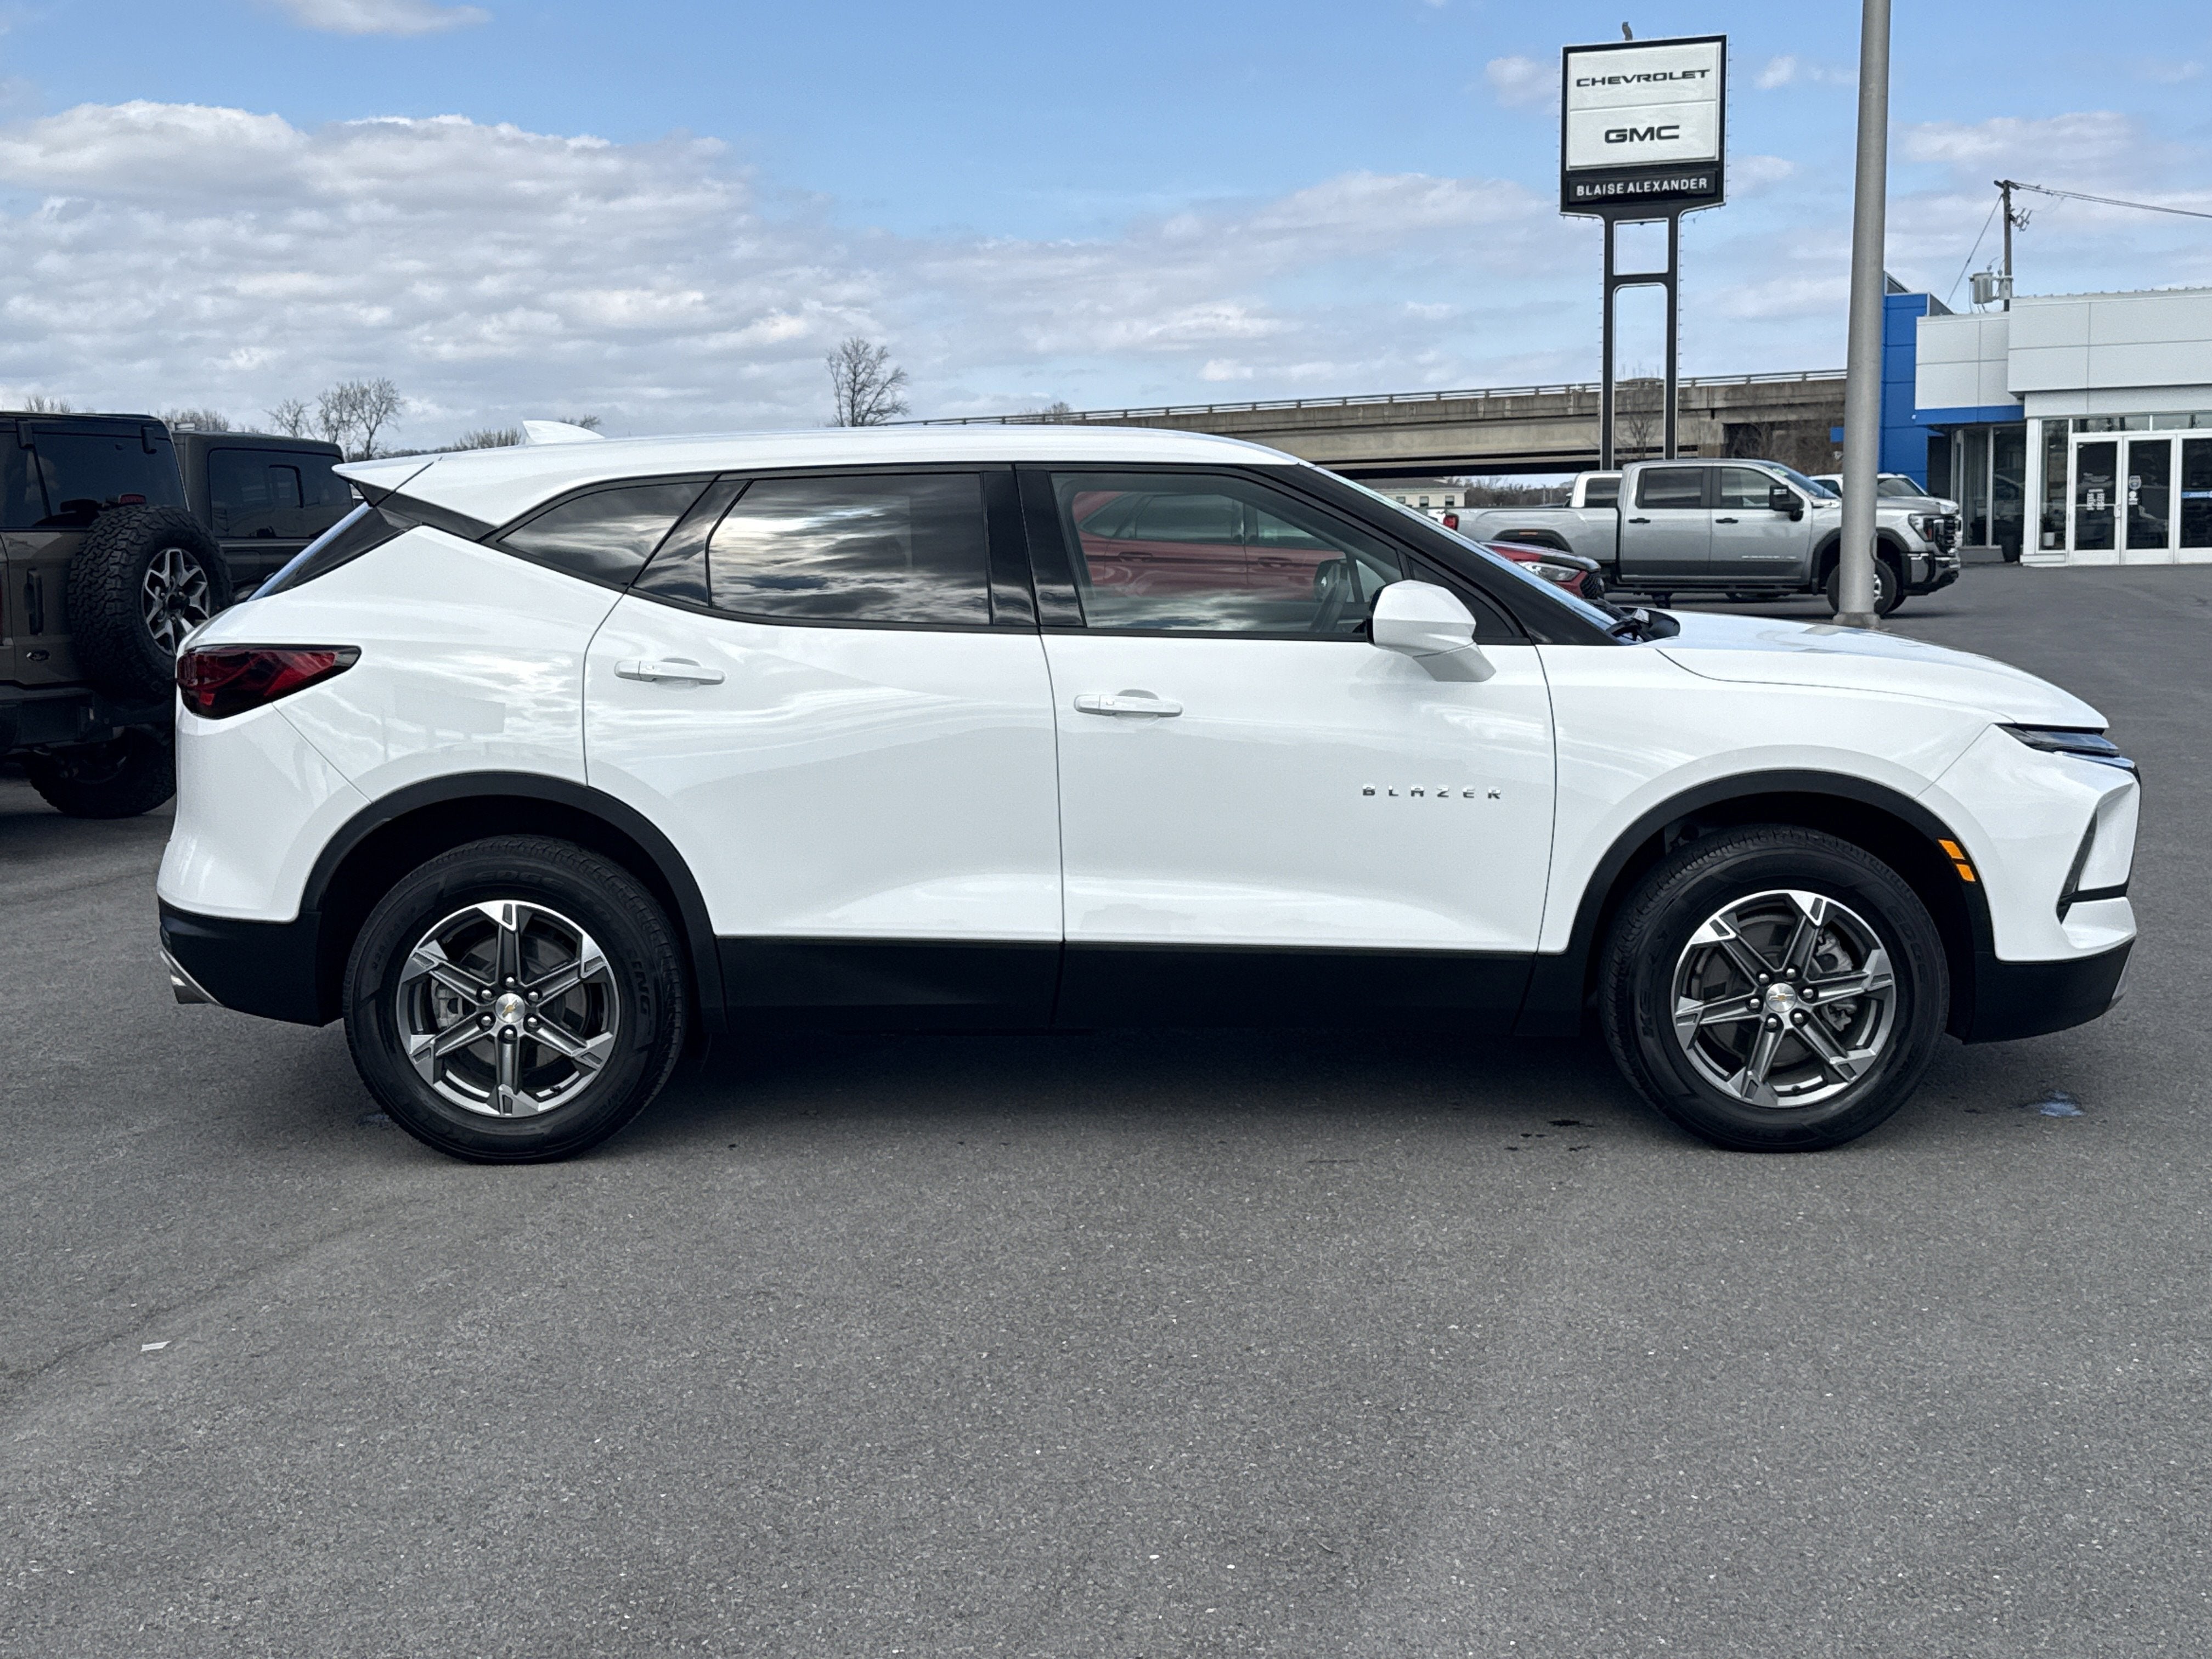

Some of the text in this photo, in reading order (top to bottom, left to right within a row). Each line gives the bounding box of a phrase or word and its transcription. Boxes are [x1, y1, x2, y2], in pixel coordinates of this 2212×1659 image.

[1576, 69, 1710, 87] CHEVROLET
[1604, 125, 1680, 144] GMC
[1576, 177, 1708, 196] BLAISE ALEXANDER
[1362, 783, 1501, 799] BLAZER
